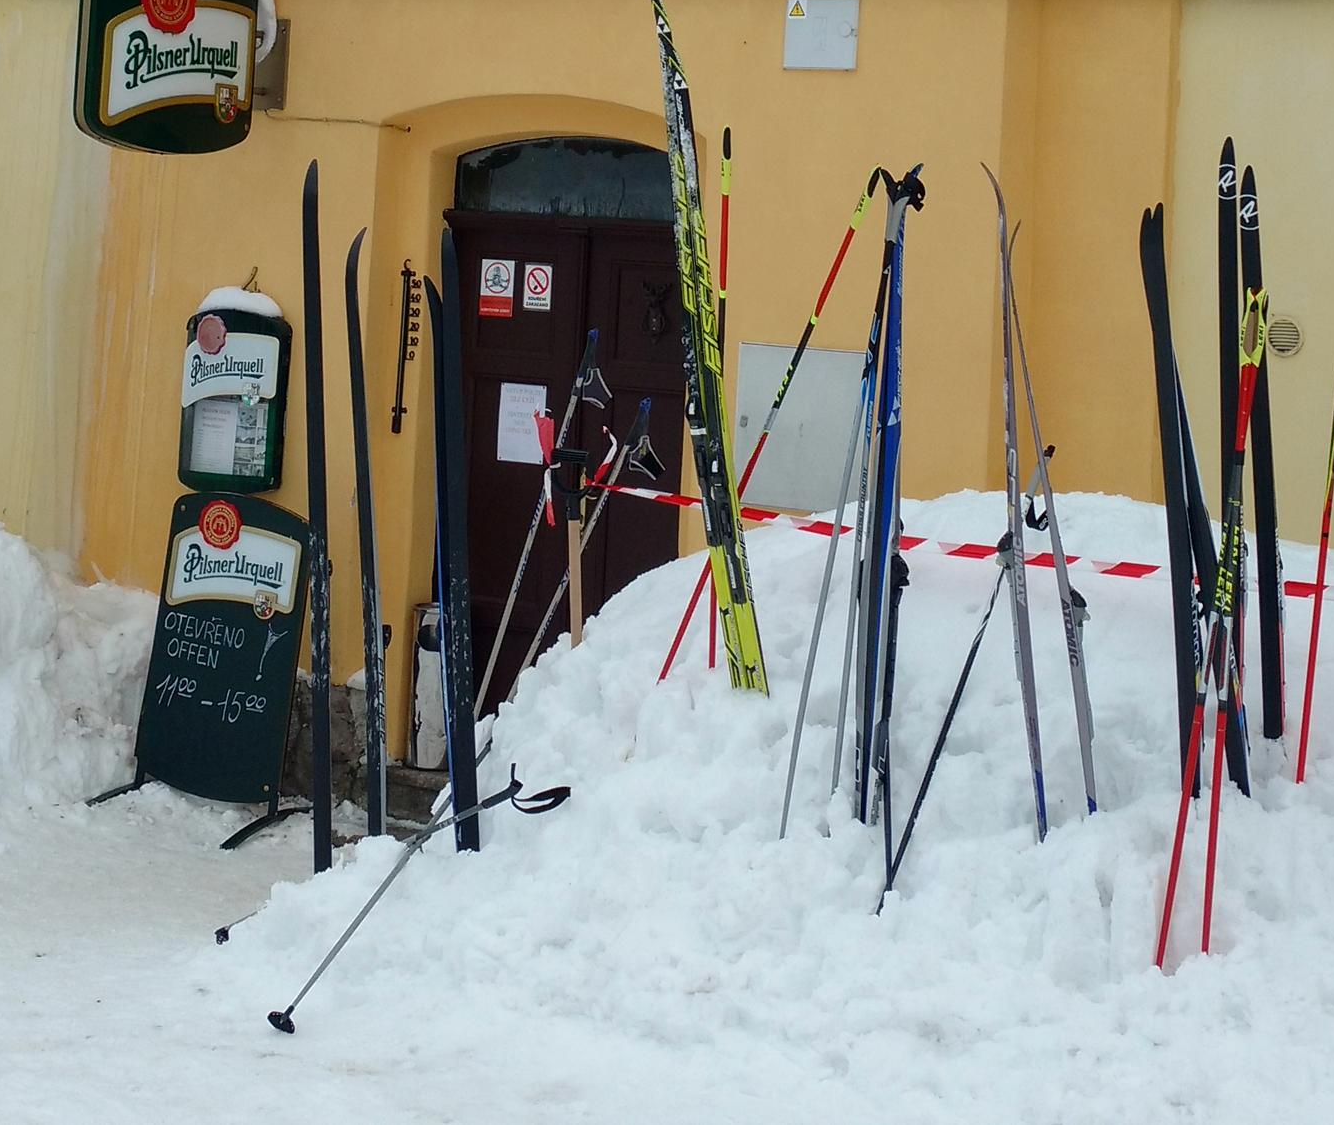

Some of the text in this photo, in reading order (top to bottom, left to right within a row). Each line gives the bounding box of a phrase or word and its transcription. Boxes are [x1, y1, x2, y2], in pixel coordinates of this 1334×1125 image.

[124, 30, 238, 90] Pilsner Urquell
[191, 354, 264, 387] Pilsner Urquell
[183, 543, 283, 586] Pilsner Urquell
[1015, 536, 1027, 608] ATOMIC
[164, 610, 245, 649] OTEVŘENO
[1061, 598, 1079, 668] ATOMIC
[167, 637, 219, 669] OFFEN
